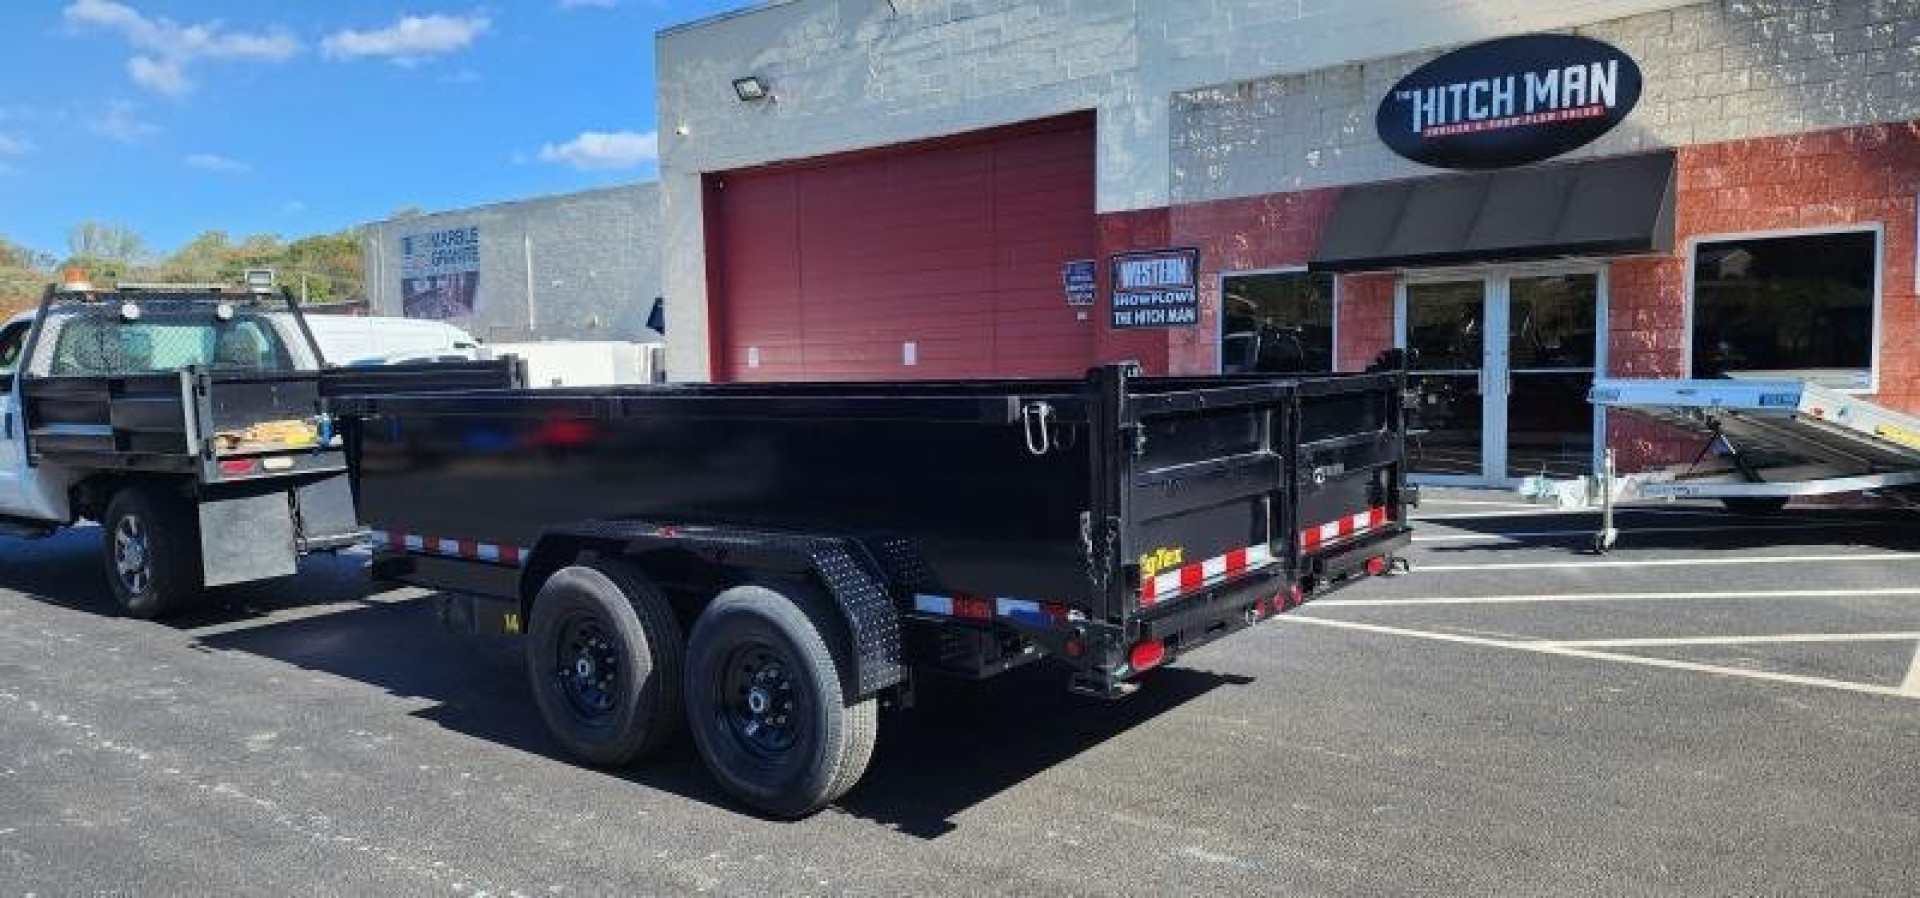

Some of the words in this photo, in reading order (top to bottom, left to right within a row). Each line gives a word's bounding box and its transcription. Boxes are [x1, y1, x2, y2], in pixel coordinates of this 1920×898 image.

[1412, 75, 1516, 133] HITCH
[1523, 59, 1619, 114] MAN
[1119, 256, 1188, 289] WESTERN
[1114, 310, 1132, 325] THE
[1134, 308, 1165, 324] HITCH
[1167, 306, 1196, 323] MAN
